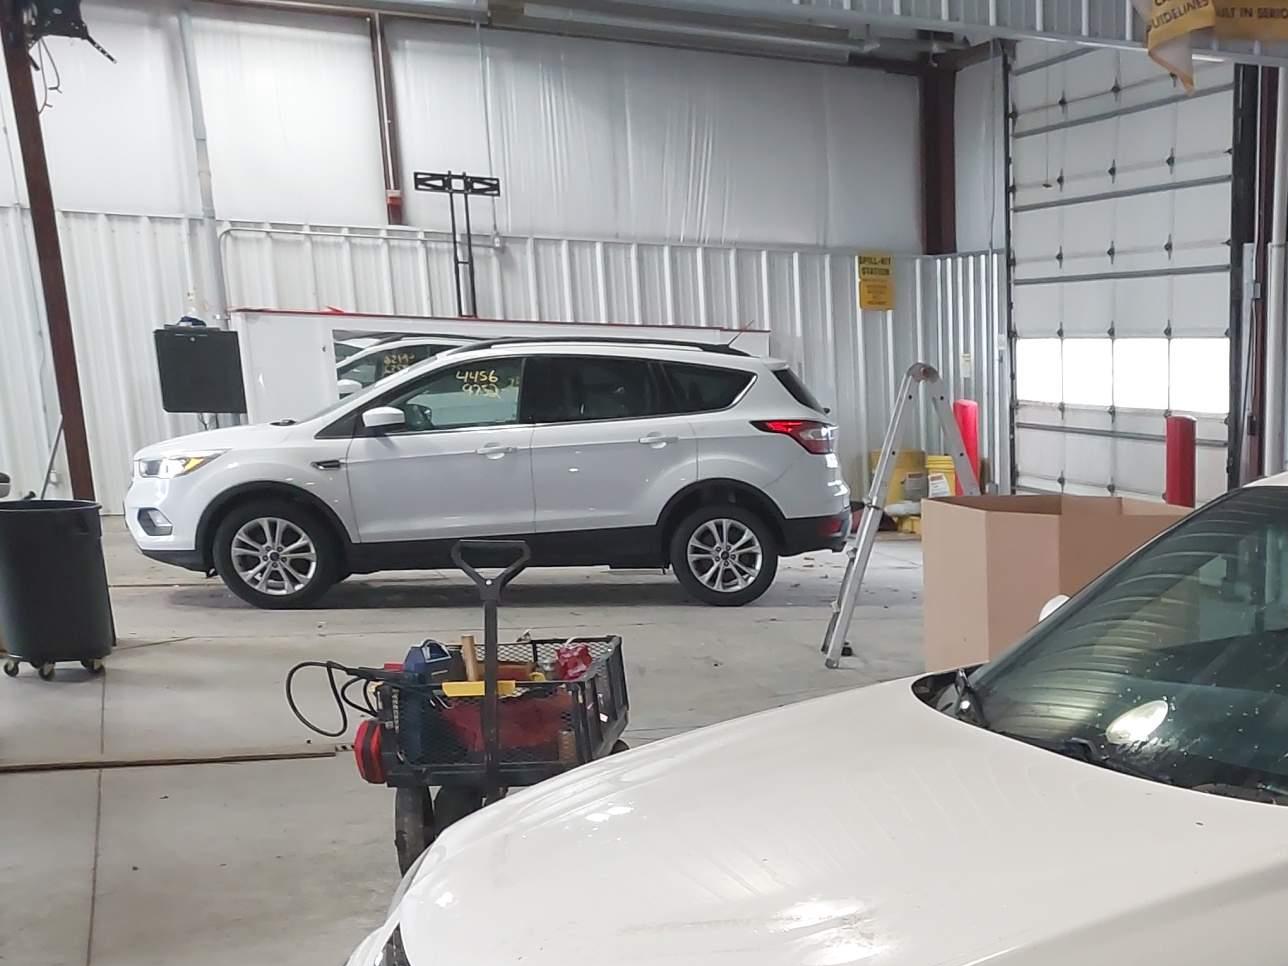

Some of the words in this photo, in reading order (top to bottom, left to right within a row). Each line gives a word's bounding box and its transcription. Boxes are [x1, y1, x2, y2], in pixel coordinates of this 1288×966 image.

[1146, 0, 1209, 33] UIDELINES
[1239, 7, 1253, 18] IN
[456, 369, 499, 383] 4456
